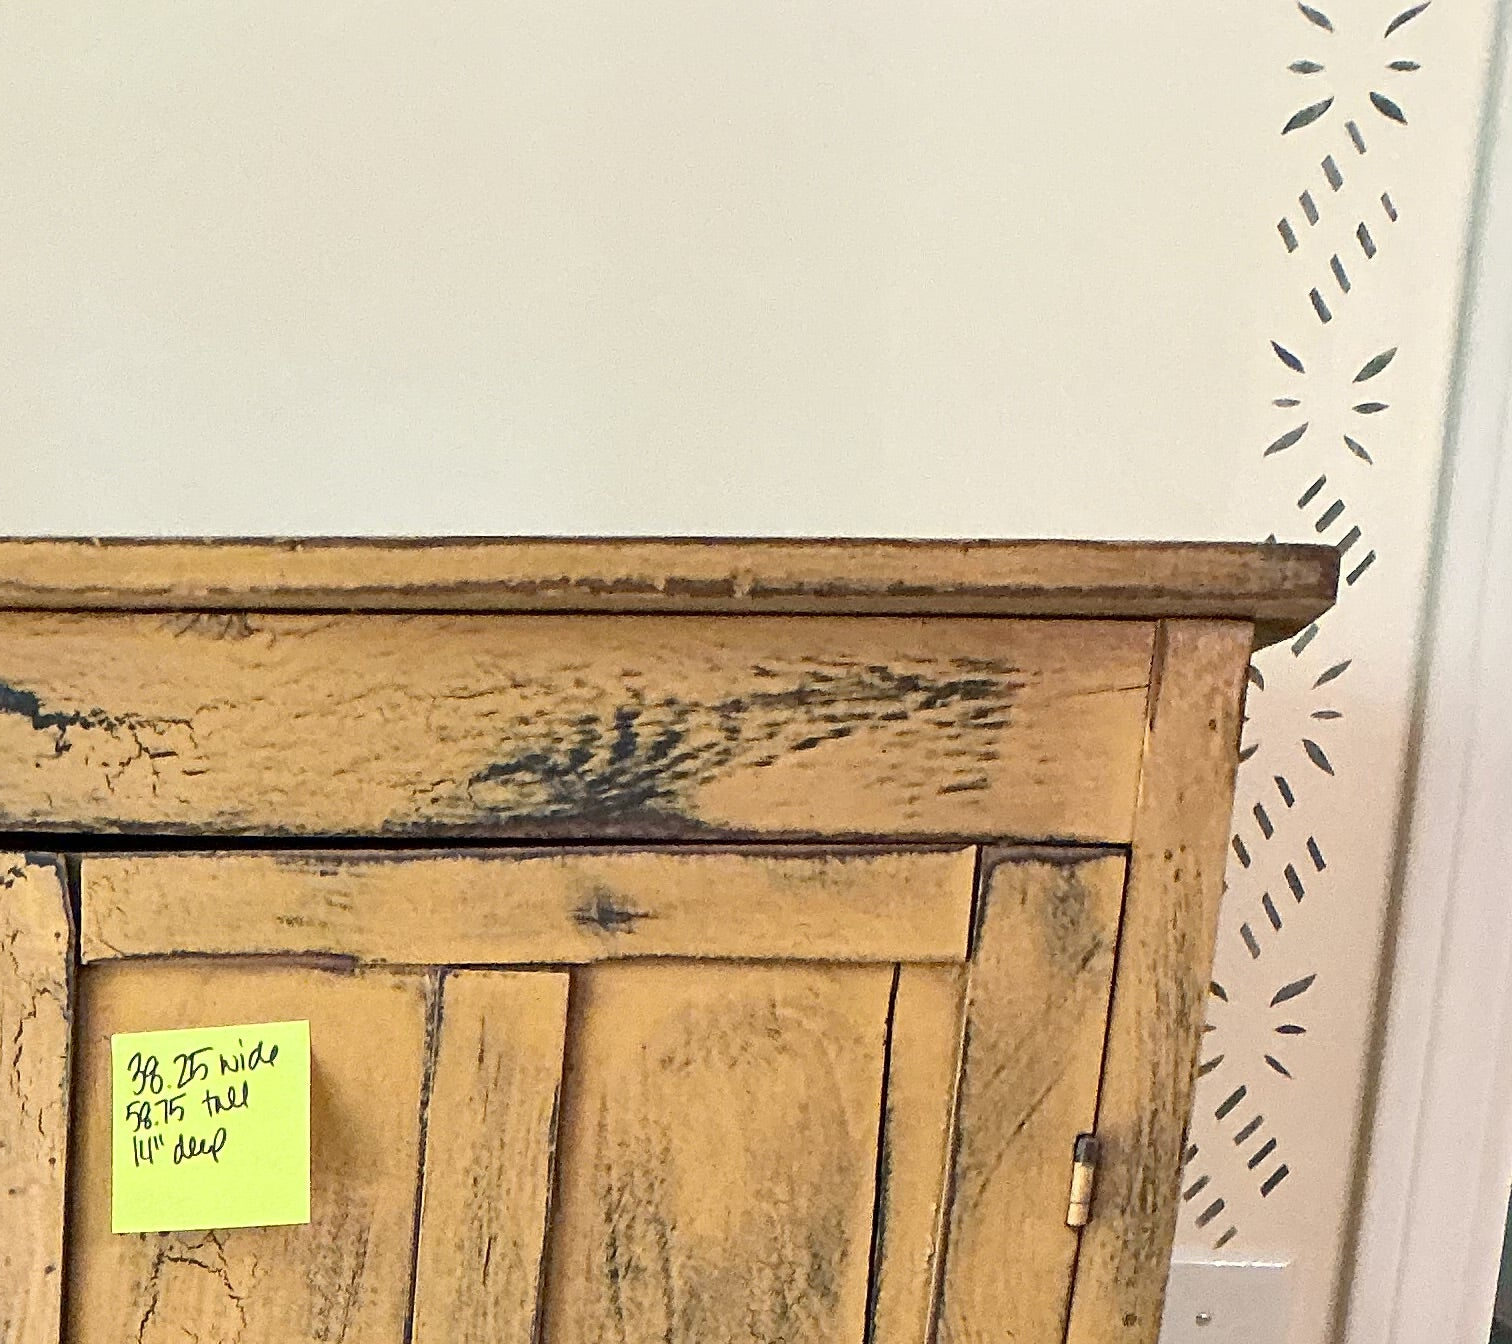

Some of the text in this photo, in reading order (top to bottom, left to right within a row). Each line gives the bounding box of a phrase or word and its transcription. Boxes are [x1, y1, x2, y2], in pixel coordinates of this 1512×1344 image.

[127, 1038, 279, 1096] 38.25 wide
[125, 1080, 249, 1132] 58.75 tall
[174, 1127, 227, 1165] deep
